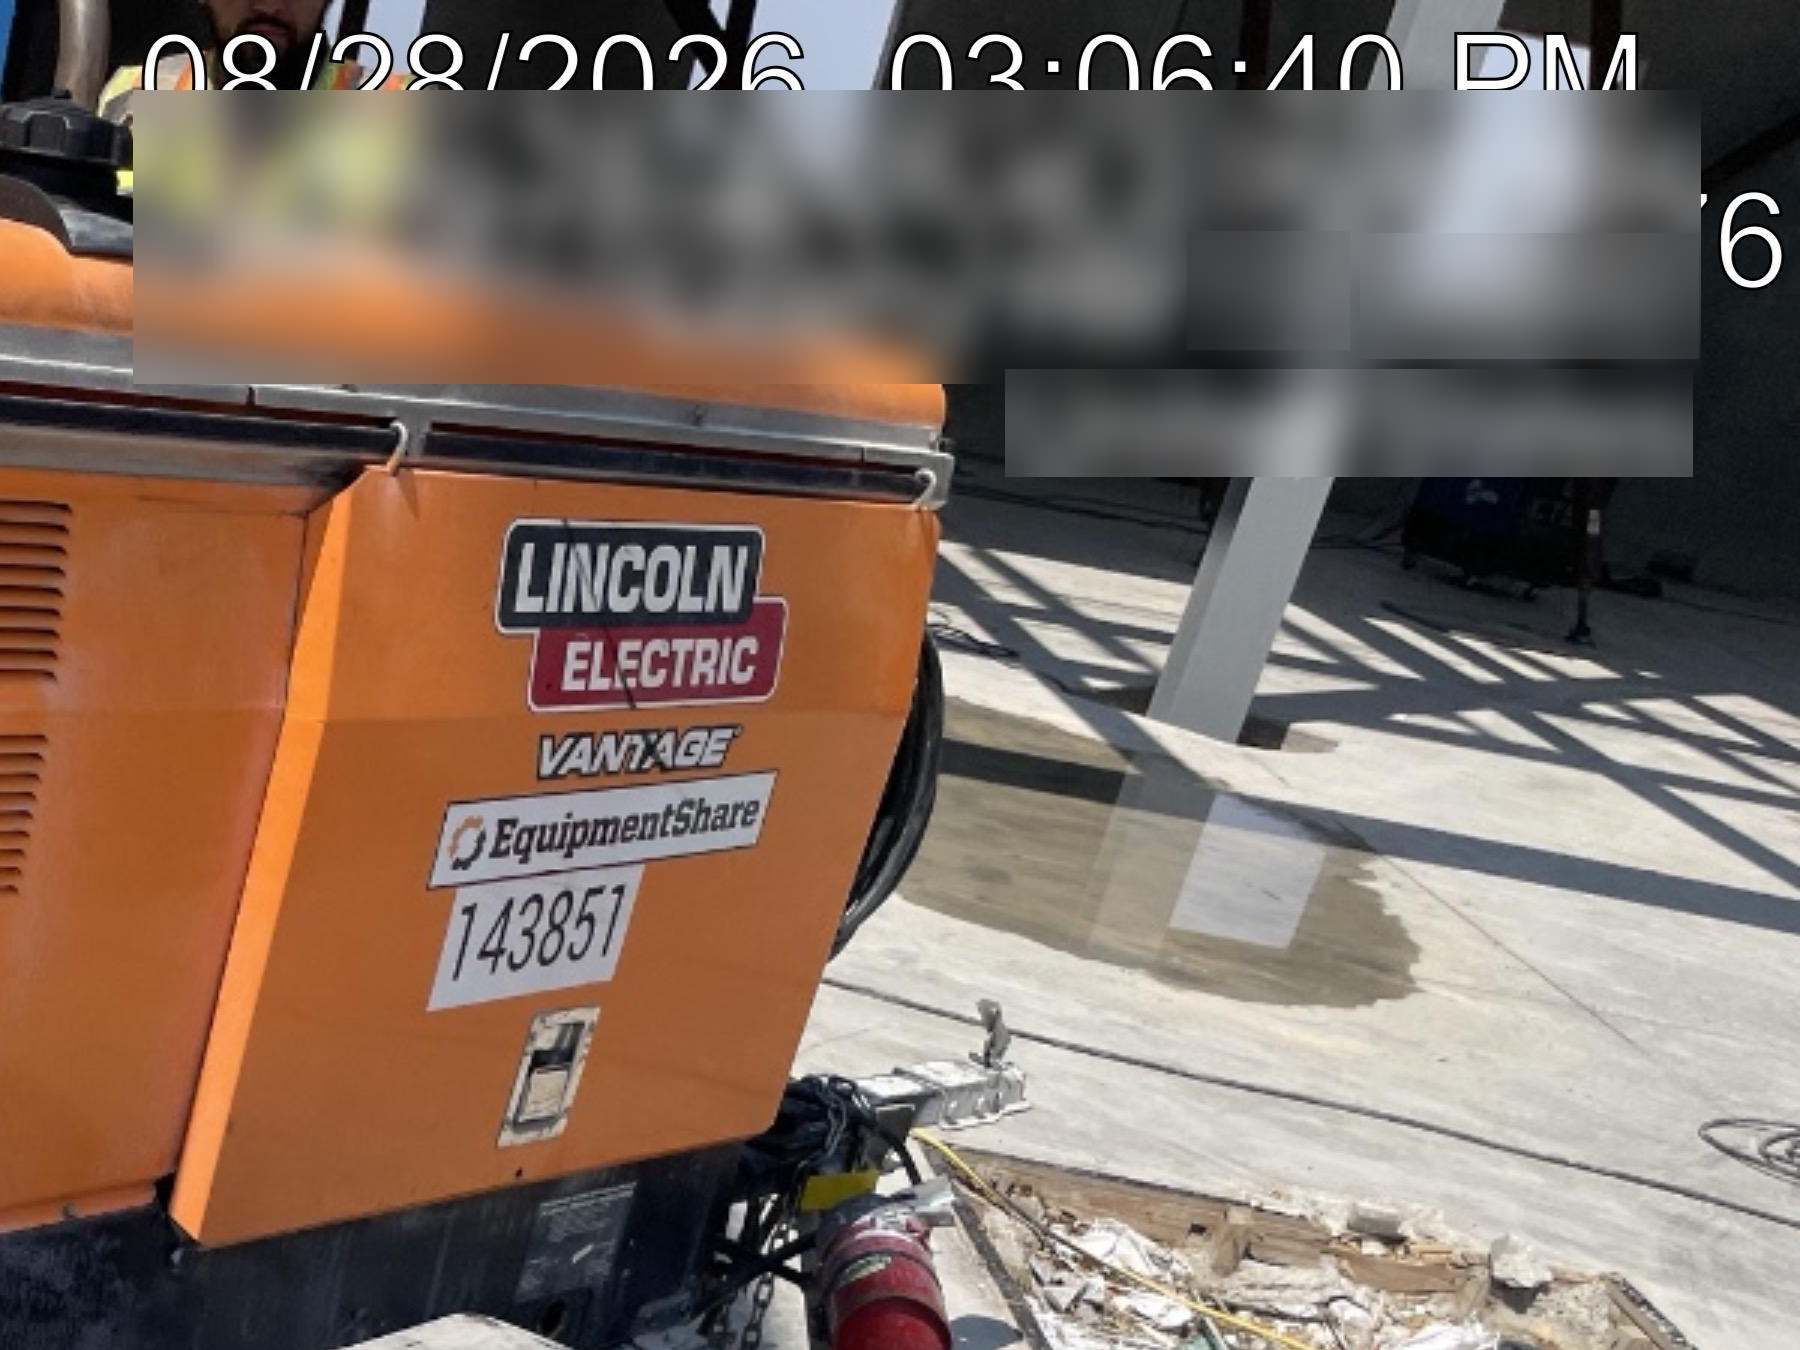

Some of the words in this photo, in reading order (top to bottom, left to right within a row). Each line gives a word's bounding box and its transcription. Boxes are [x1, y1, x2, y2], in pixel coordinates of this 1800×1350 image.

[514, 542, 749, 614] LINCOLN
[561, 635, 760, 692] ELECTRIC
[538, 725, 738, 780] VANTAGE
[488, 798, 761, 865] EquipmentShare
[452, 884, 627, 982] 143851
